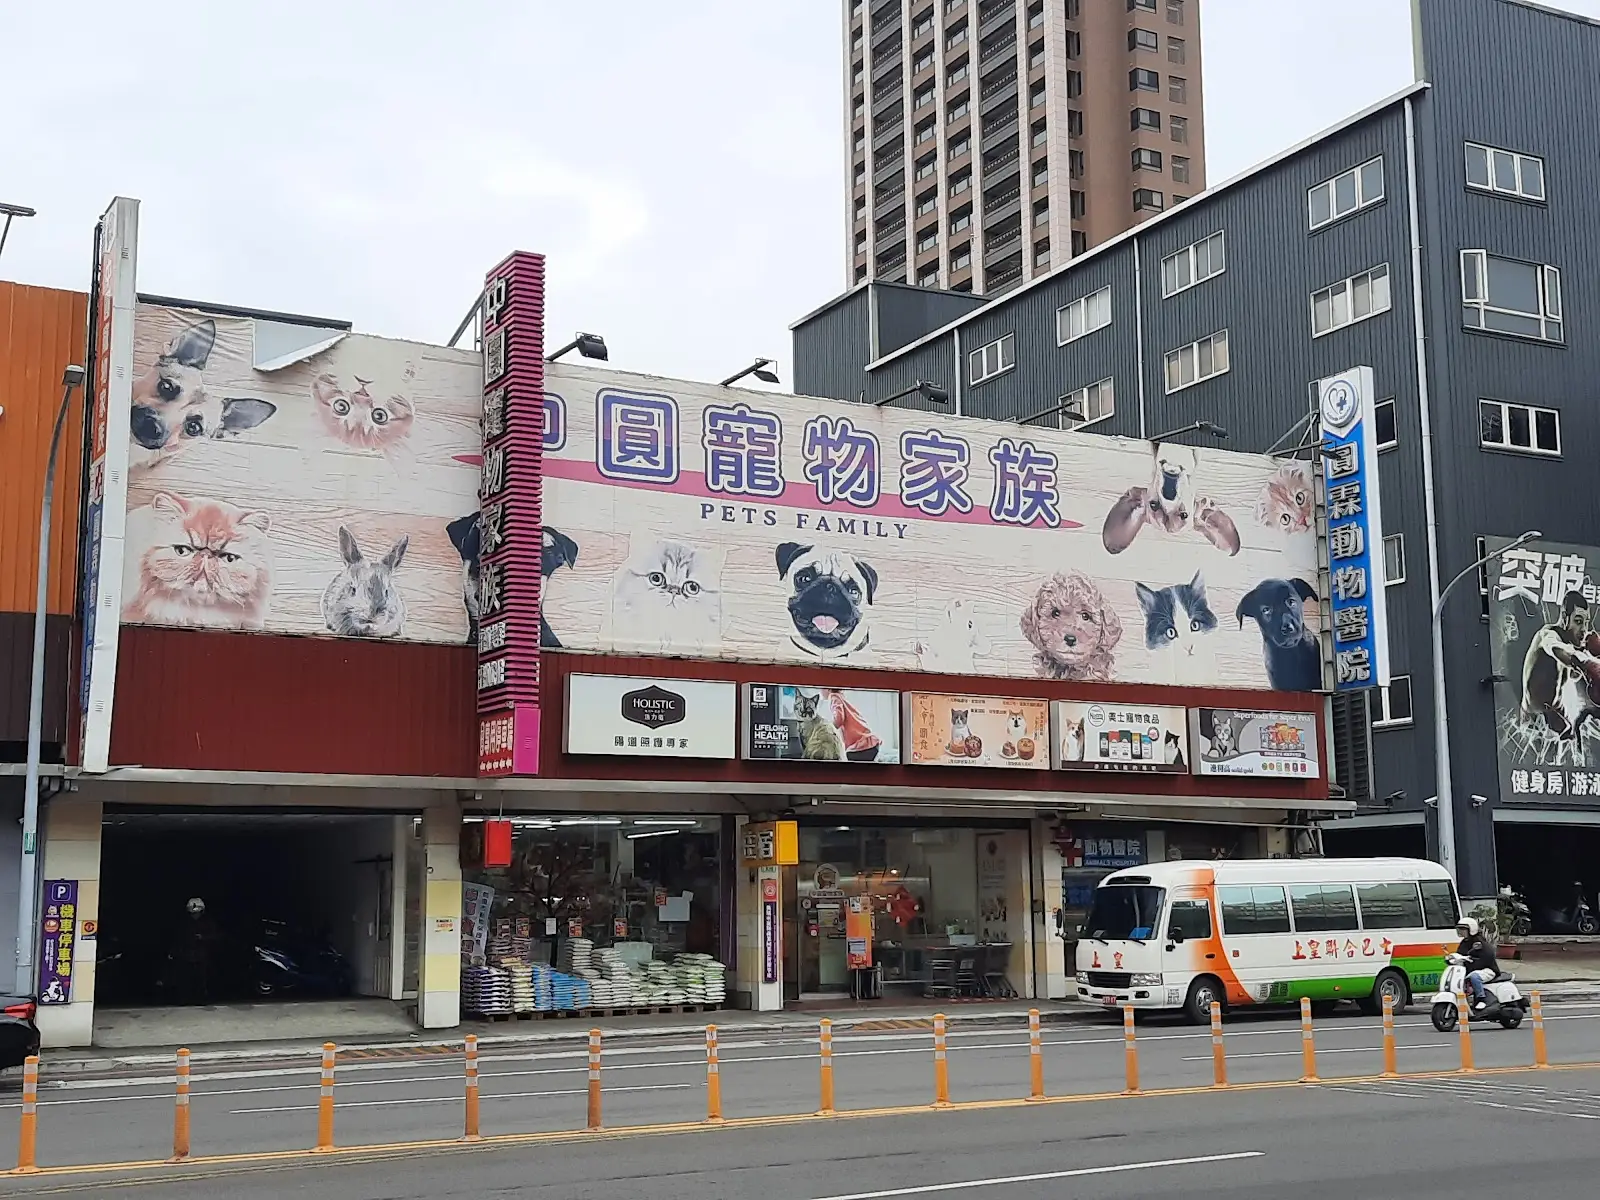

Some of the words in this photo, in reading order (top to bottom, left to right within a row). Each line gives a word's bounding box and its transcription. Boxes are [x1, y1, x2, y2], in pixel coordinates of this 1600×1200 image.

[700, 503, 777, 526] PETS
[796, 513, 908, 539] FAMILY
[633, 697, 676, 710] HOLISTIC
[754, 723, 789, 732] LIFELONG
[754, 731, 789, 741] HEALTH
[1084, 839, 1140, 856] 動物醫院
[57, 885, 66, 899] P
[56, 903, 75, 977] 機車停車場
[1091, 950, 1124, 970] 上皇
